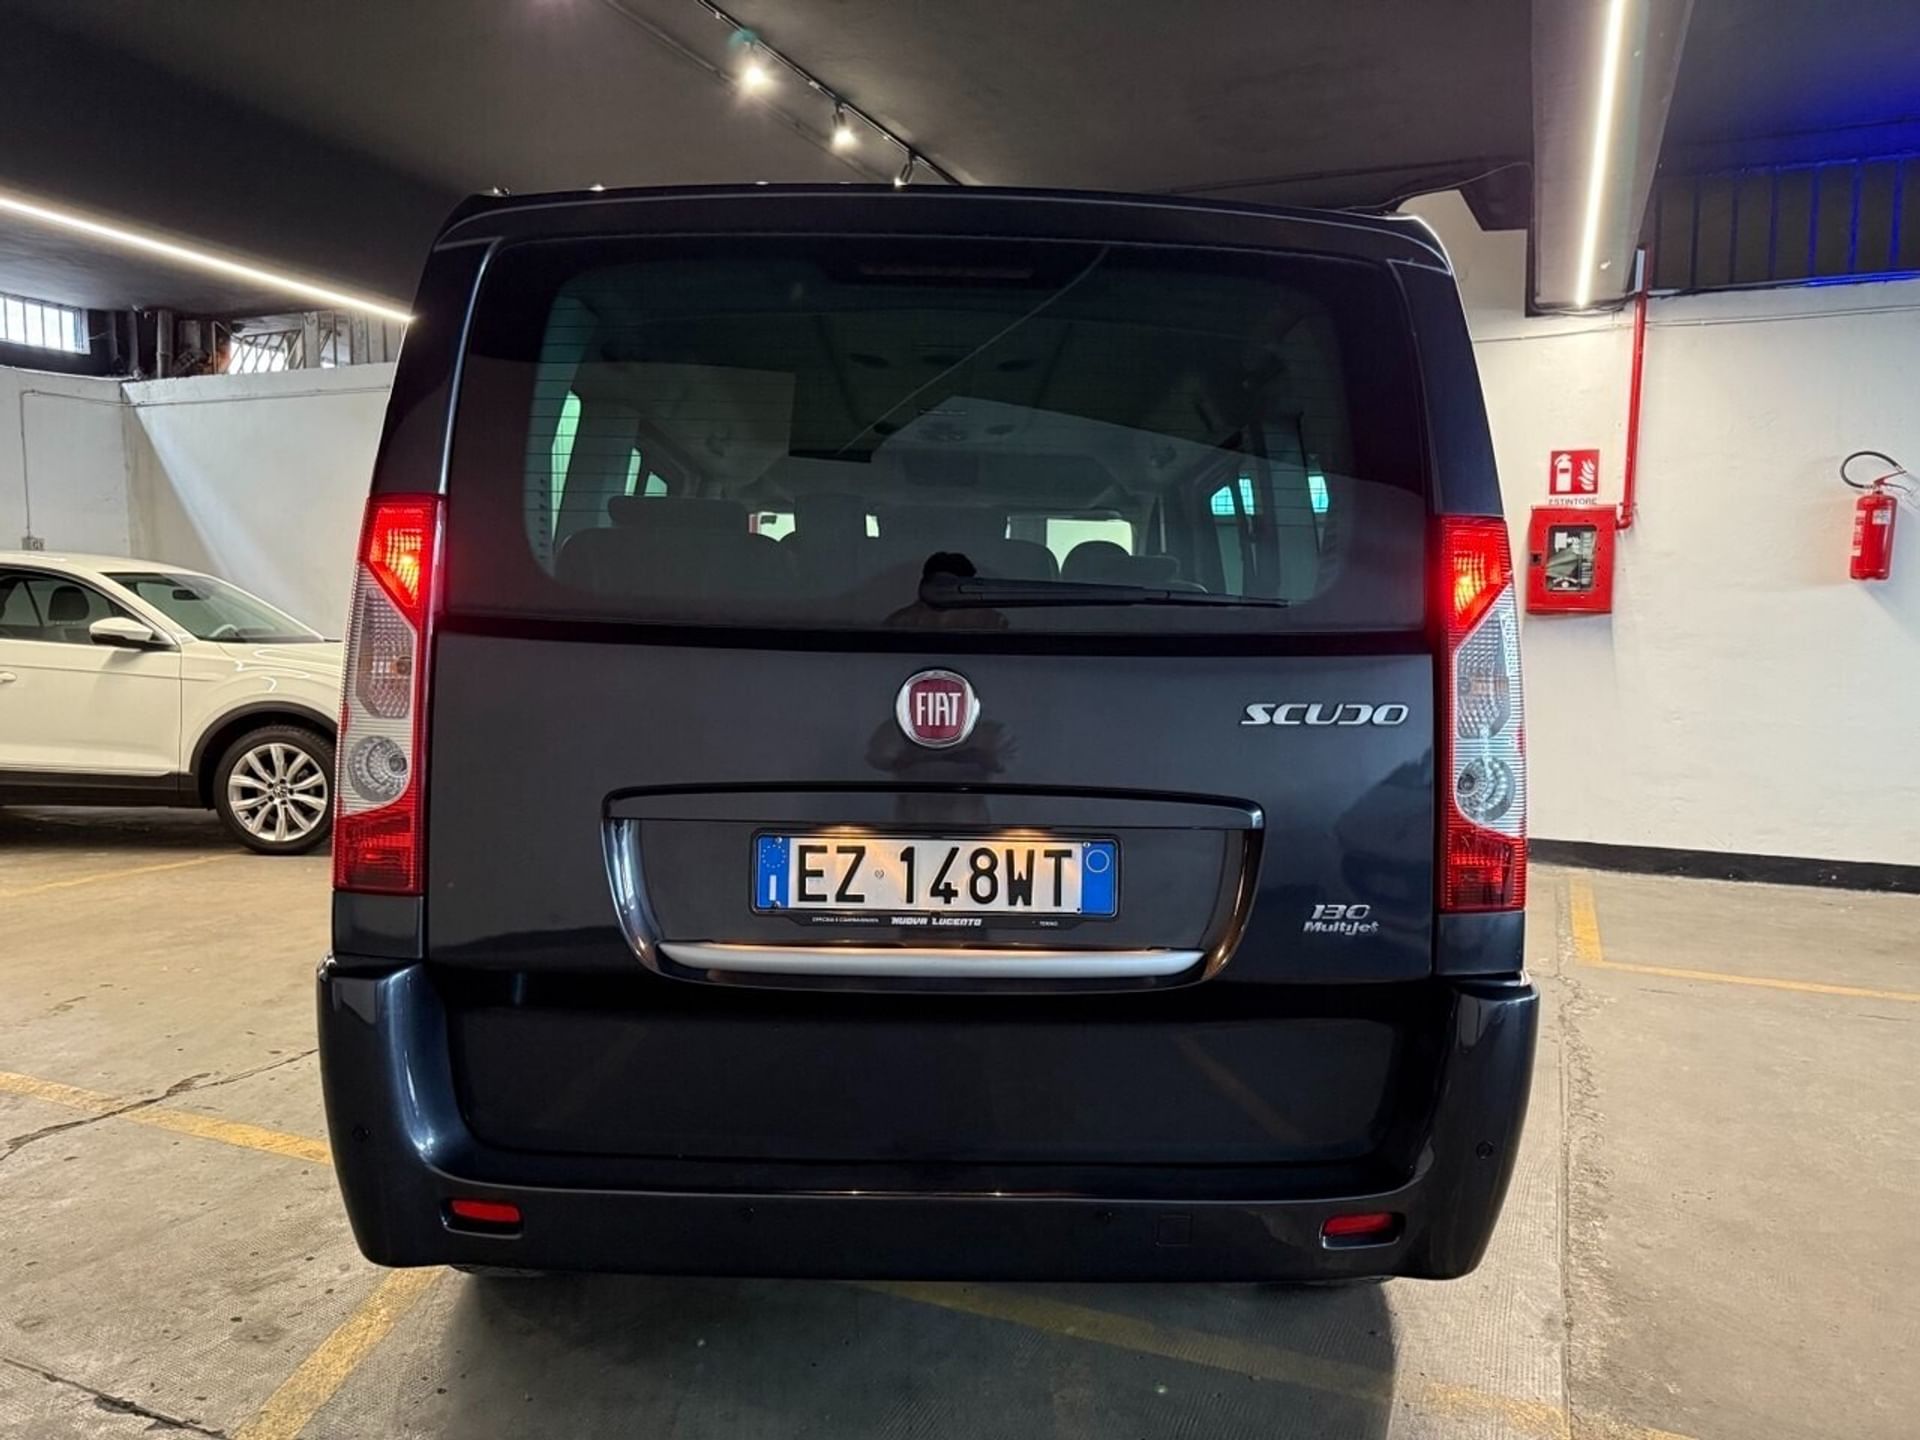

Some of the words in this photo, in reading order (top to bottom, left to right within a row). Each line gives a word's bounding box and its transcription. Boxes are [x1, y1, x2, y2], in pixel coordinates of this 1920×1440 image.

[916, 692, 961, 726] FIAT
[1241, 703, 1409, 725] SCUDO
[797, 845, 866, 903] EZ
[900, 846, 1073, 907] 148WT
[891, 916, 928, 926] NUOVA
[932, 917, 982, 927] LUCENTO
[1311, 904, 1371, 919] 130
